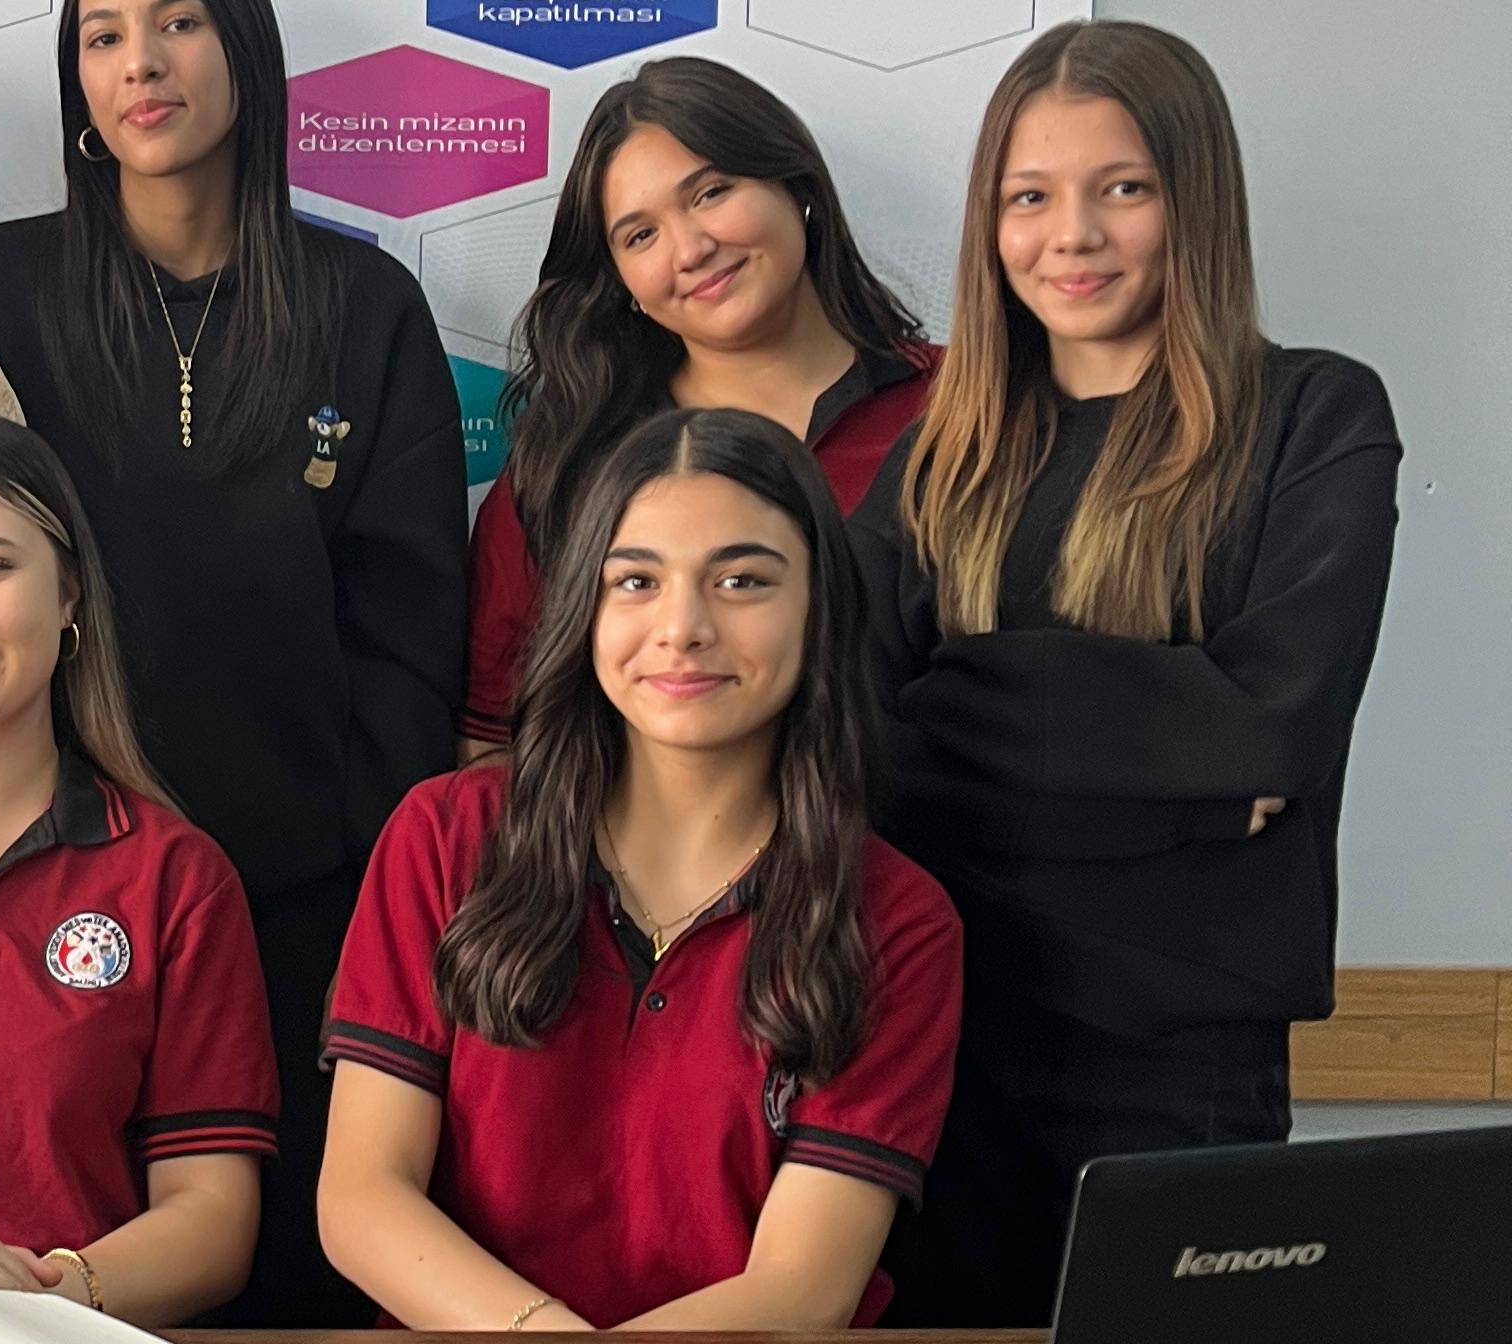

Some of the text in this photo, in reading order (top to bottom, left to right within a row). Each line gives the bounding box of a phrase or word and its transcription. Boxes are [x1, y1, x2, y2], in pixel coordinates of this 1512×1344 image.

[477, 3, 664, 26] kapatılması
[299, 112, 526, 131] Kesin mizanın
[298, 134, 526, 153] düzenlenmesi
[464, 439, 488, 452] sı
[1174, 1239, 1327, 1278] lenovo
